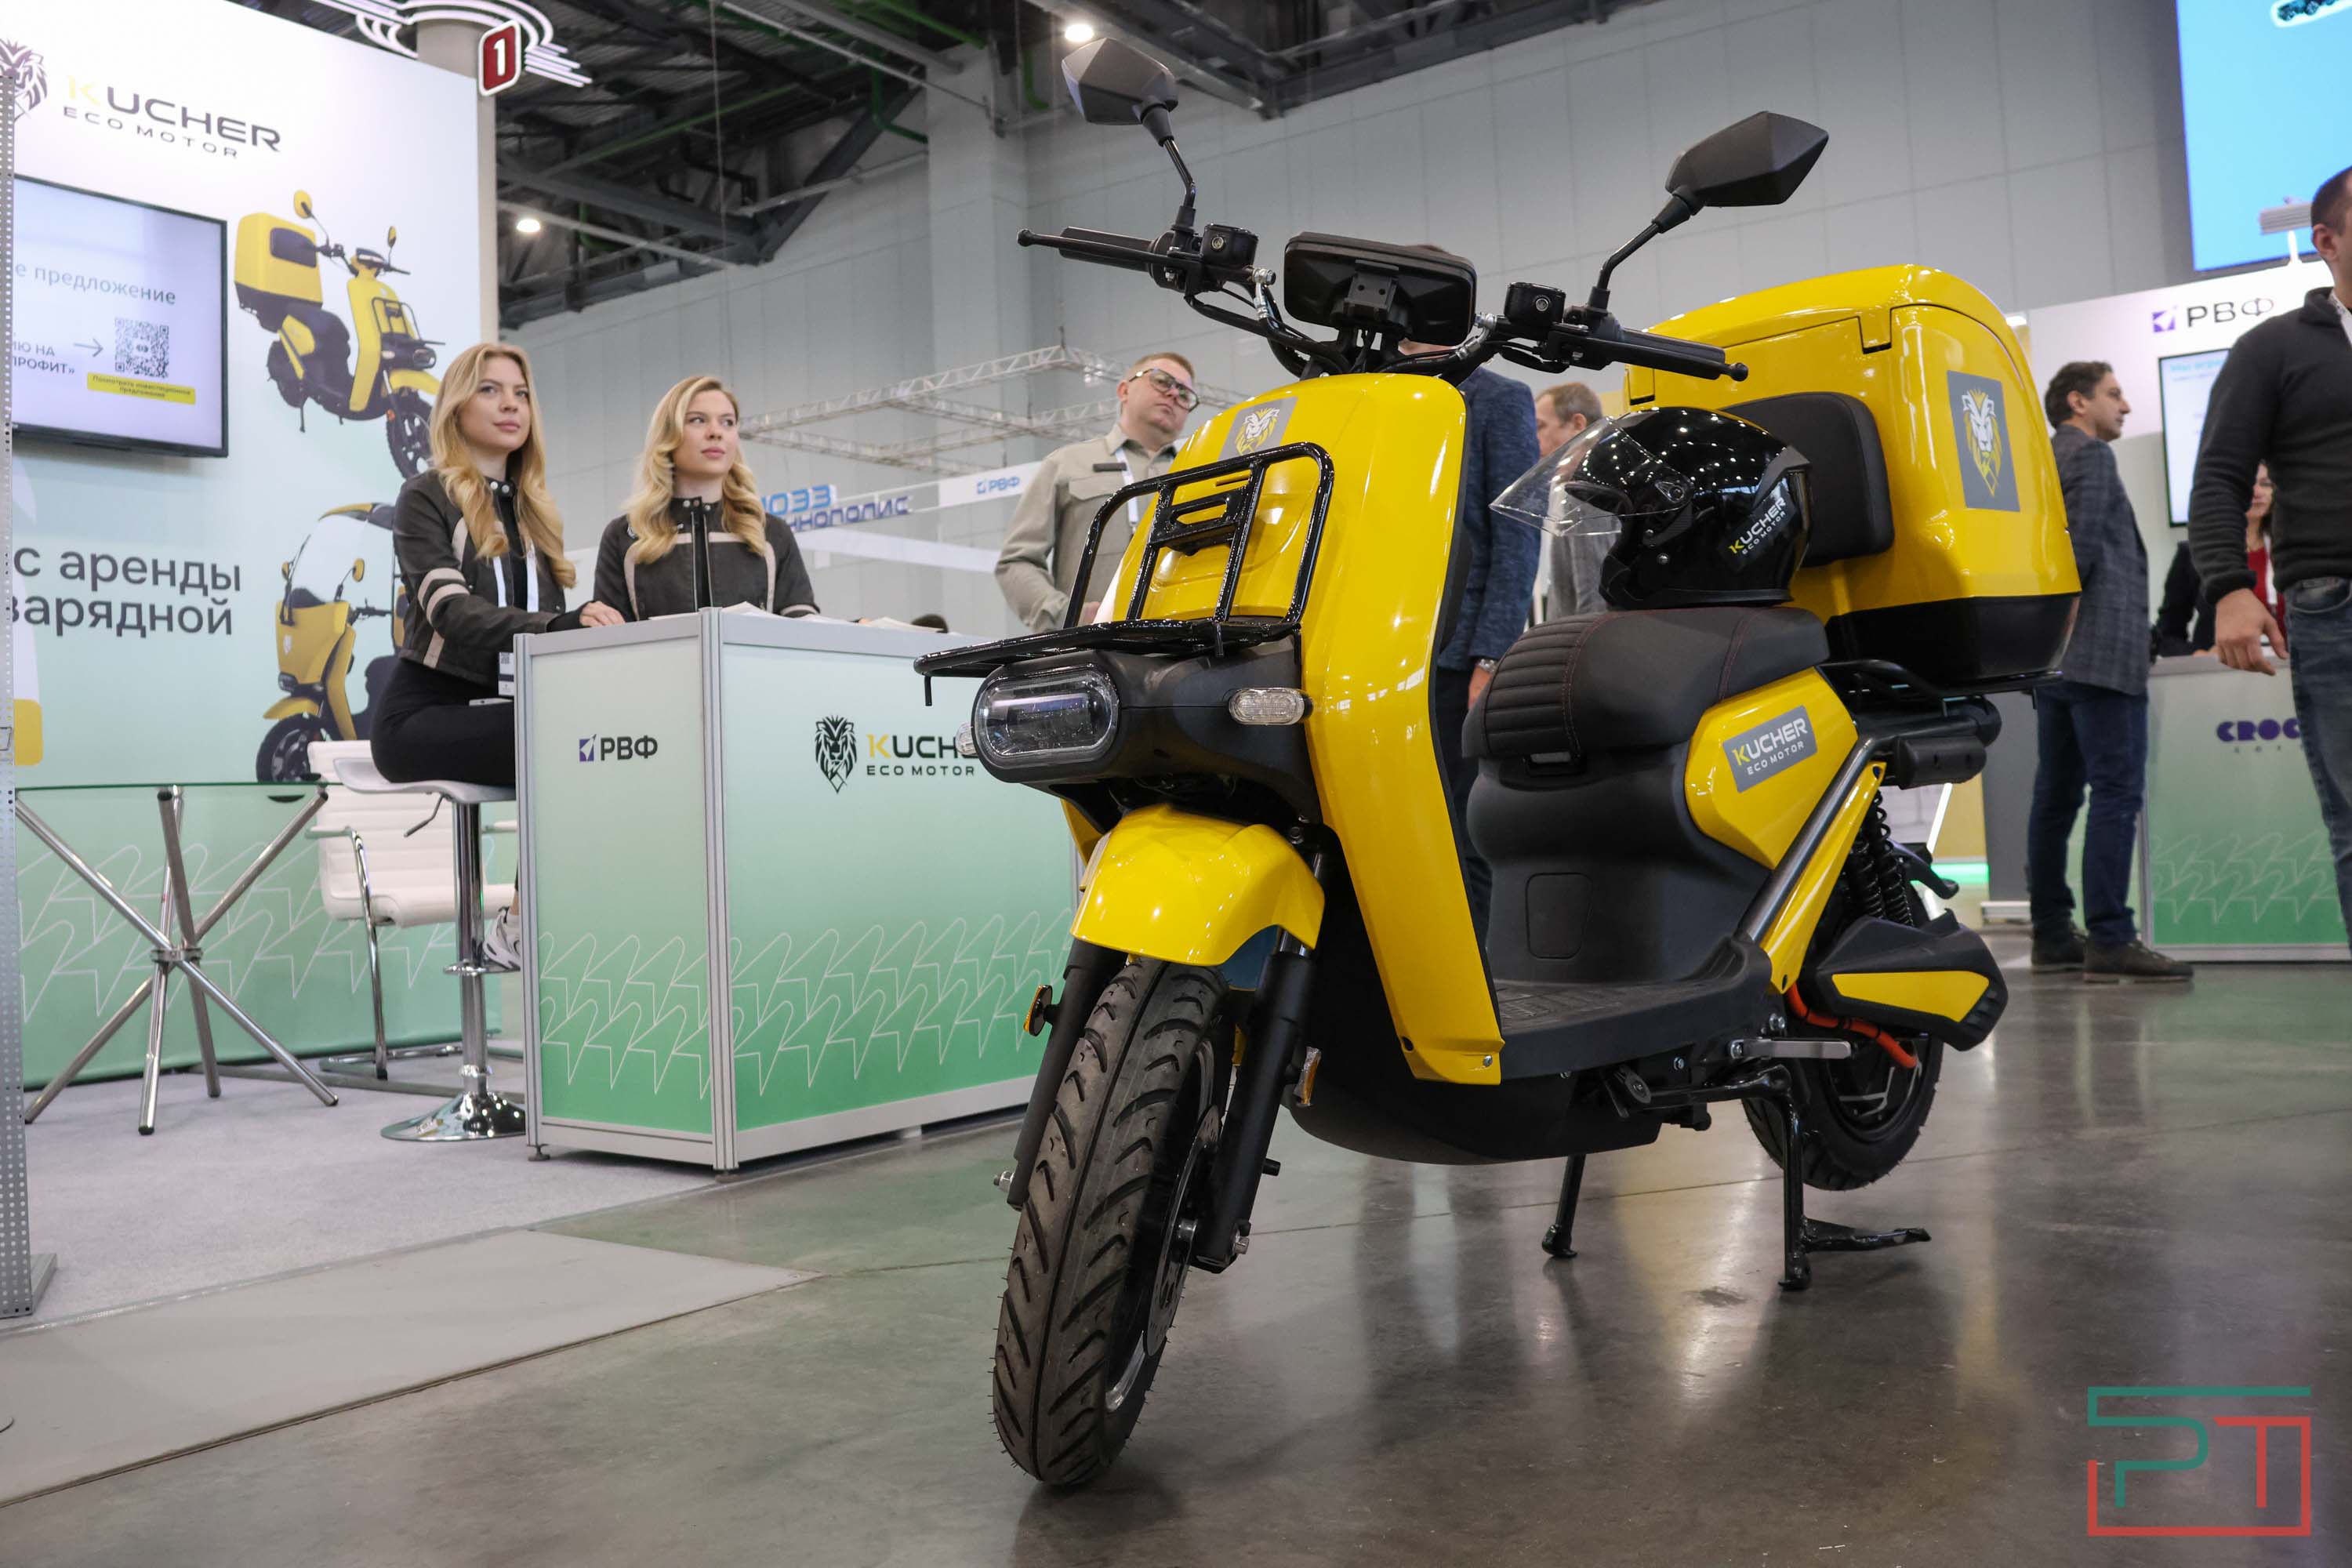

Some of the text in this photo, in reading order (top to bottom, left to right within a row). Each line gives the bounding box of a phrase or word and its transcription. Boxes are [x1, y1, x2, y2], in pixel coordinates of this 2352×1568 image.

[493, 38, 506, 76] 1
[67, 74, 281, 152] KUCHER
[63, 106, 238, 159] ECO MOTOR
[34, 267, 176, 305] предложение
[2187, 297, 2274, 328] РВФ
[35, 343, 56, 357] НА
[1729, 496, 1787, 554] KUCHER
[1742, 510, 1786, 555] ECO MOTOR
[60, 551, 241, 597] аренды
[600, 735, 659, 761] РВФ
[866, 734, 979, 759] KUCH
[1732, 717, 1808, 766] KUCHER
[1746, 740, 1804, 775] ECO MOTOR
[866, 765, 975, 776] ECO MOTOR
